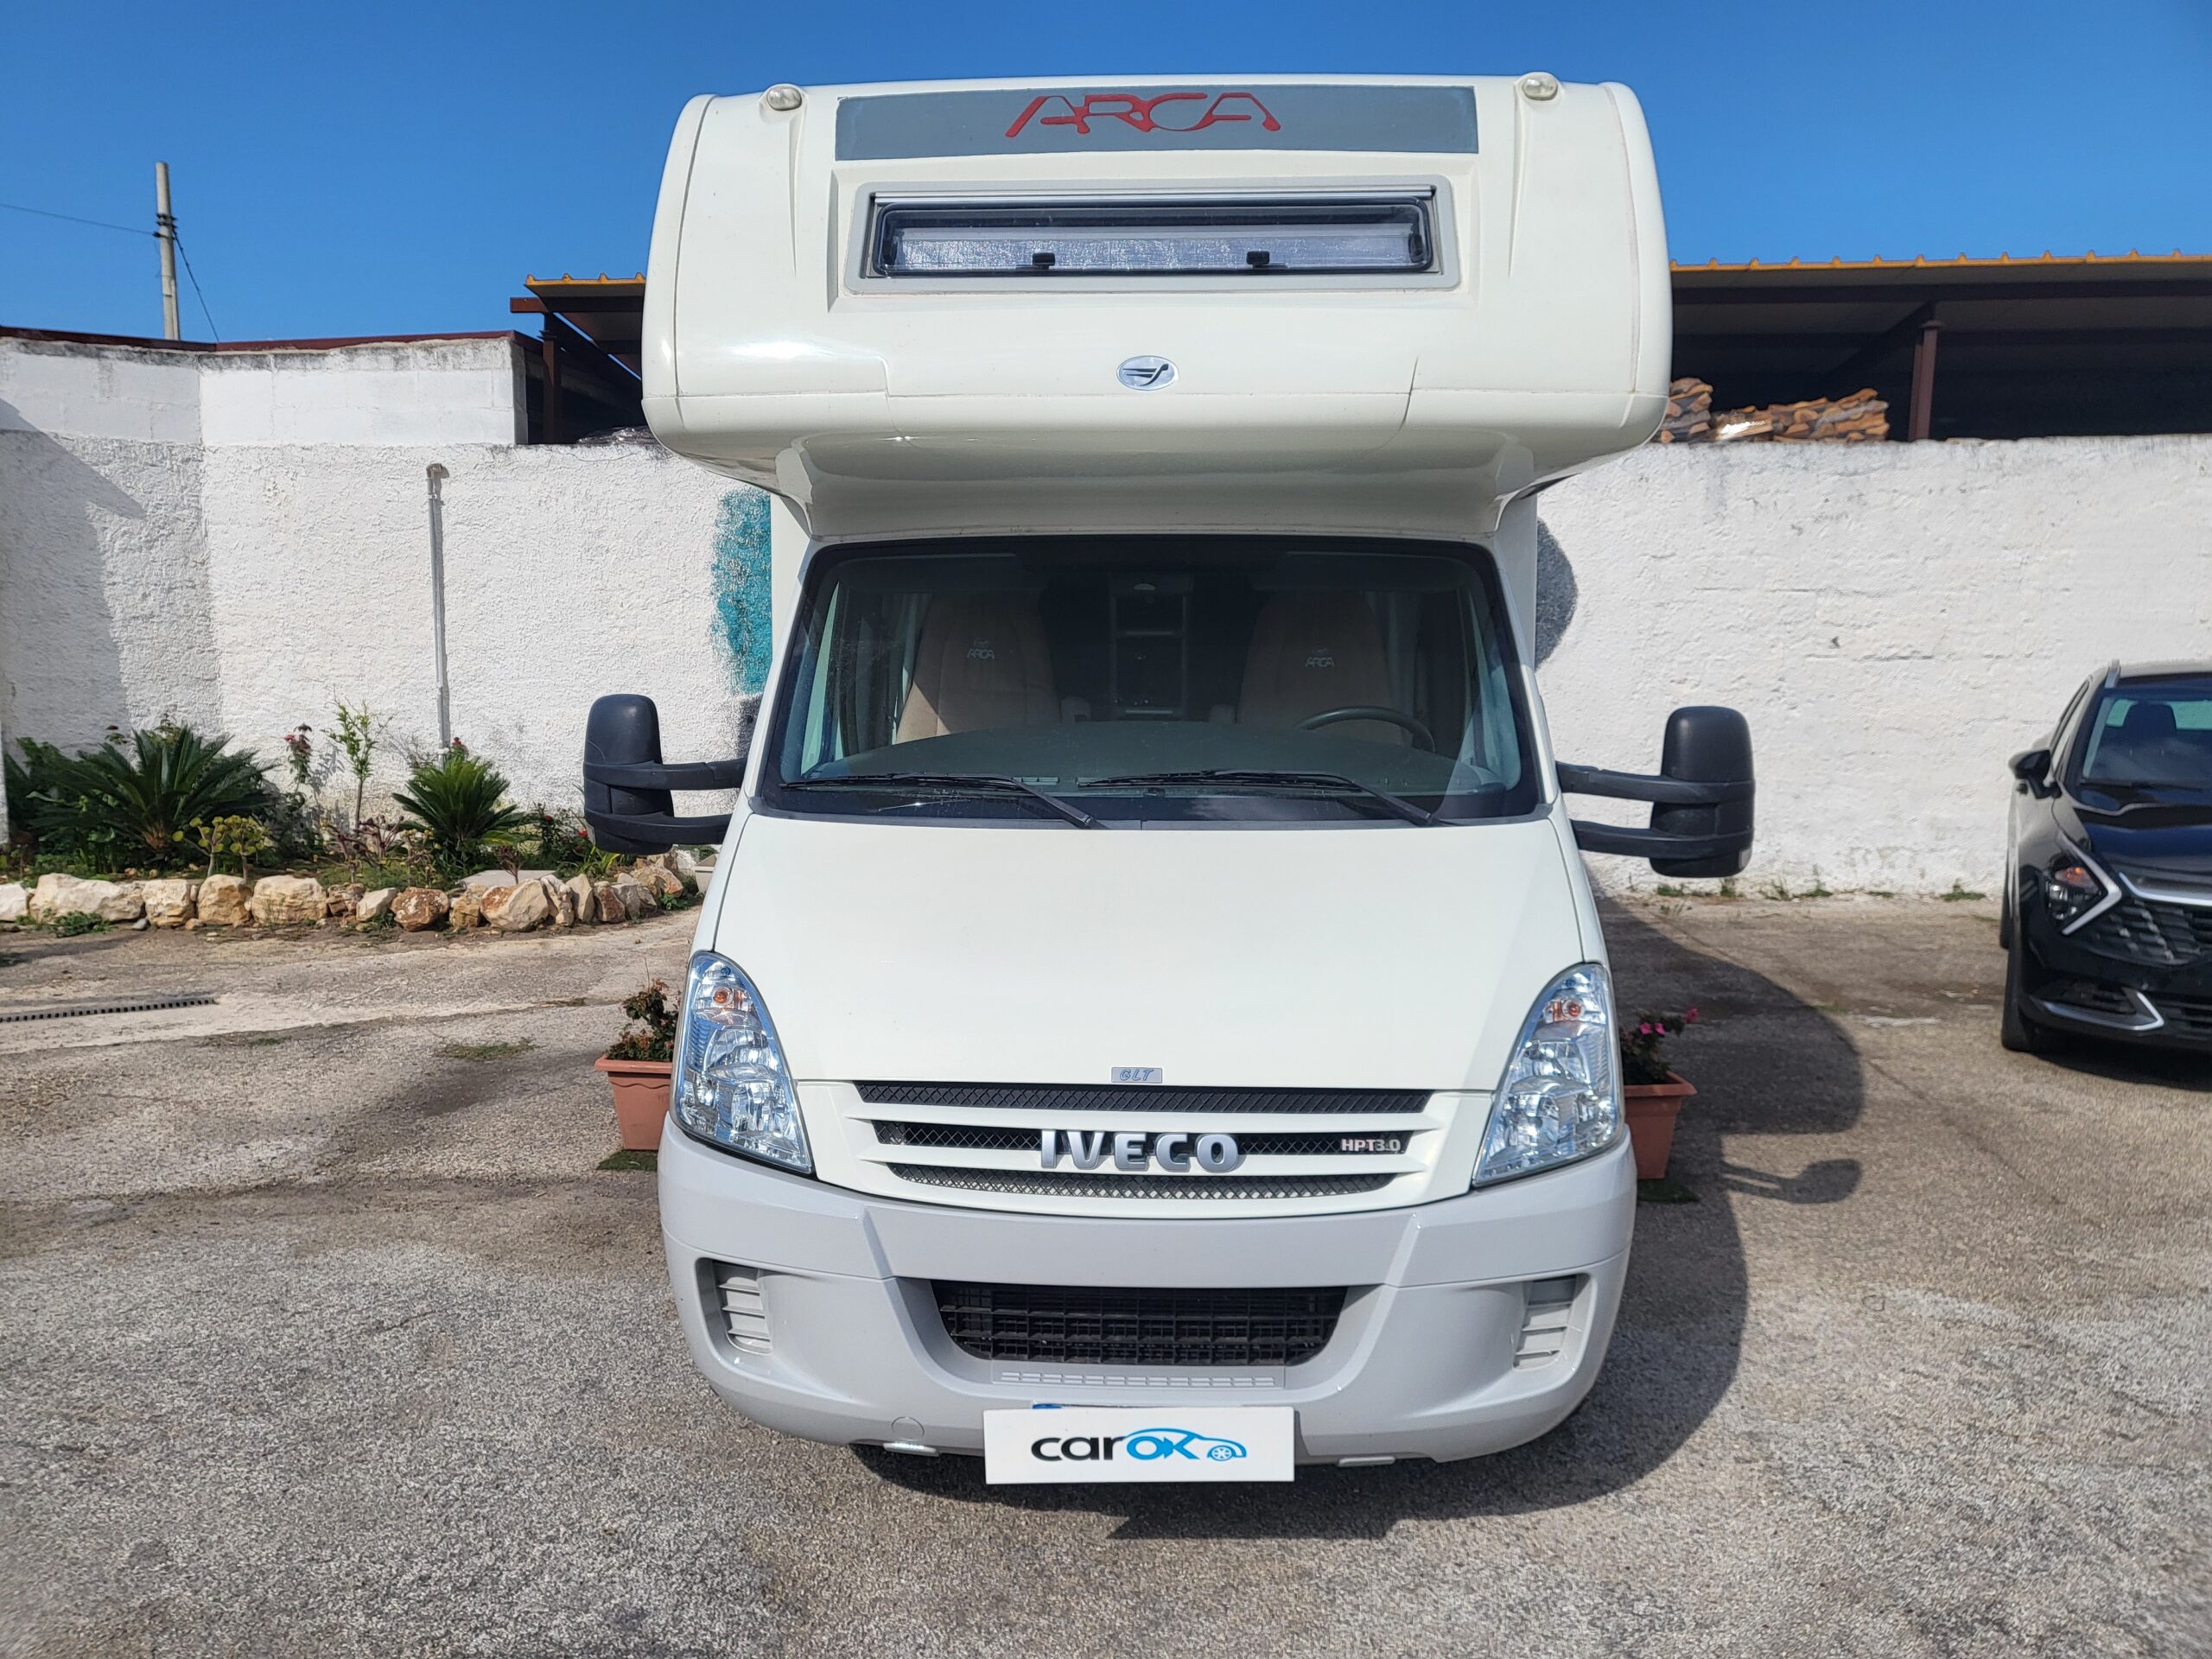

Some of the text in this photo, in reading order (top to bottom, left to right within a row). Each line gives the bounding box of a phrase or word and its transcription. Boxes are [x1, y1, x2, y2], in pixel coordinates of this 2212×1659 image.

[1005, 92, 1281, 137] ARCA
[967, 649, 995, 659] ARCA
[1305, 657, 1334, 668] ARCA
[1119, 1068, 1154, 1081] GLT
[1040, 1129, 1242, 1173] IVECO
